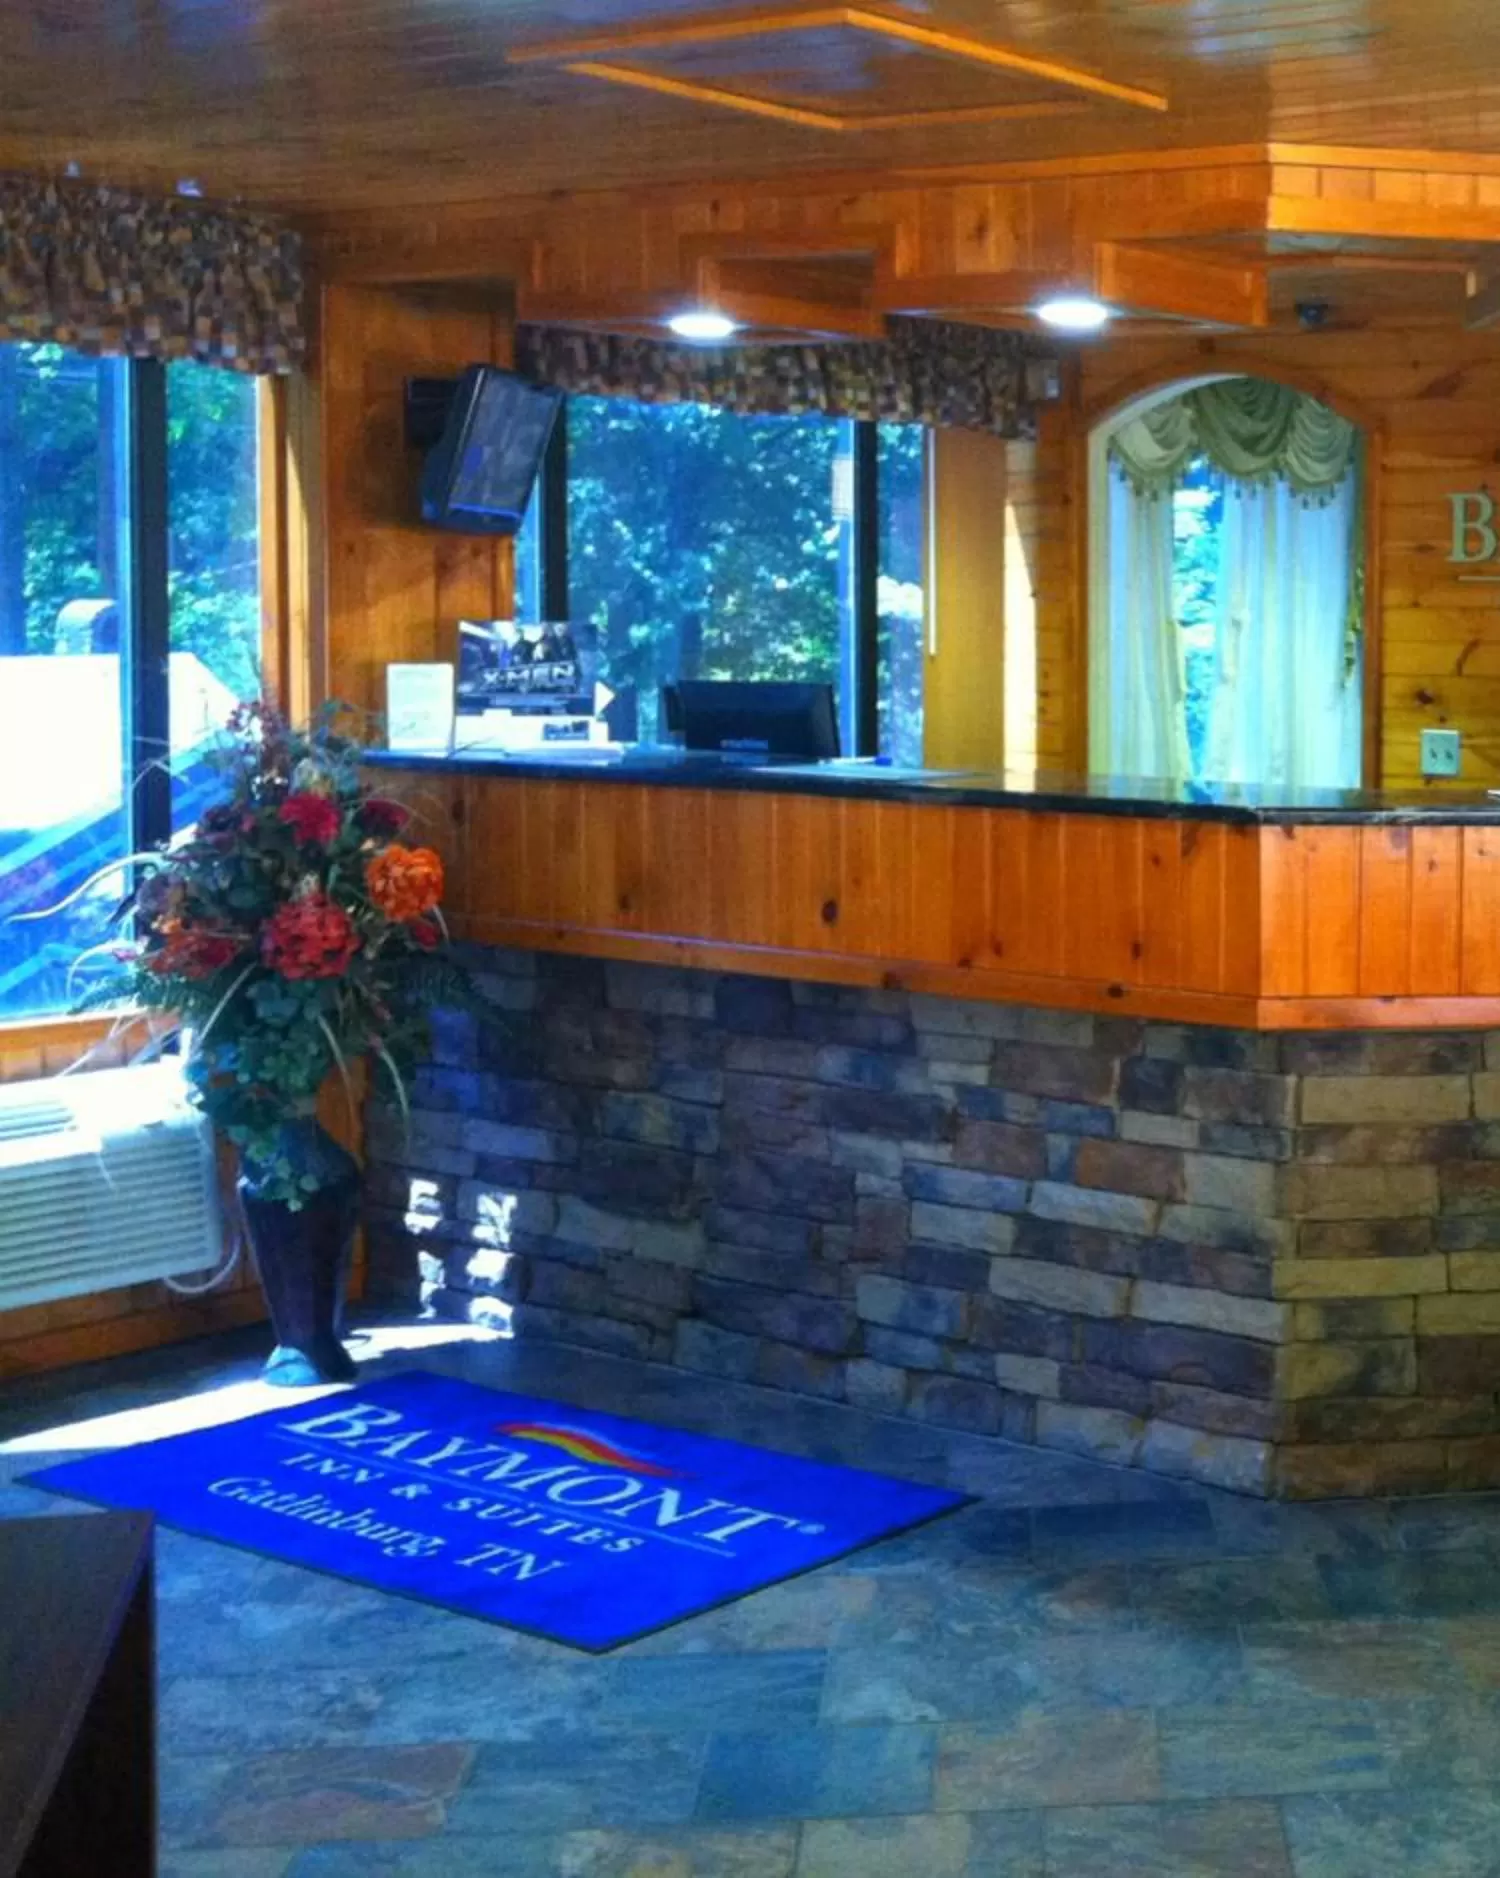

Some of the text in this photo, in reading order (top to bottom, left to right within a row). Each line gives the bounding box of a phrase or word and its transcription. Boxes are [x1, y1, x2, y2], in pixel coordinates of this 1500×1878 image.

[276, 1403, 801, 1543] BAYMONT
[279, 1453, 645, 1552] INN & SUITES
[454, 1543, 569, 1581] TN
